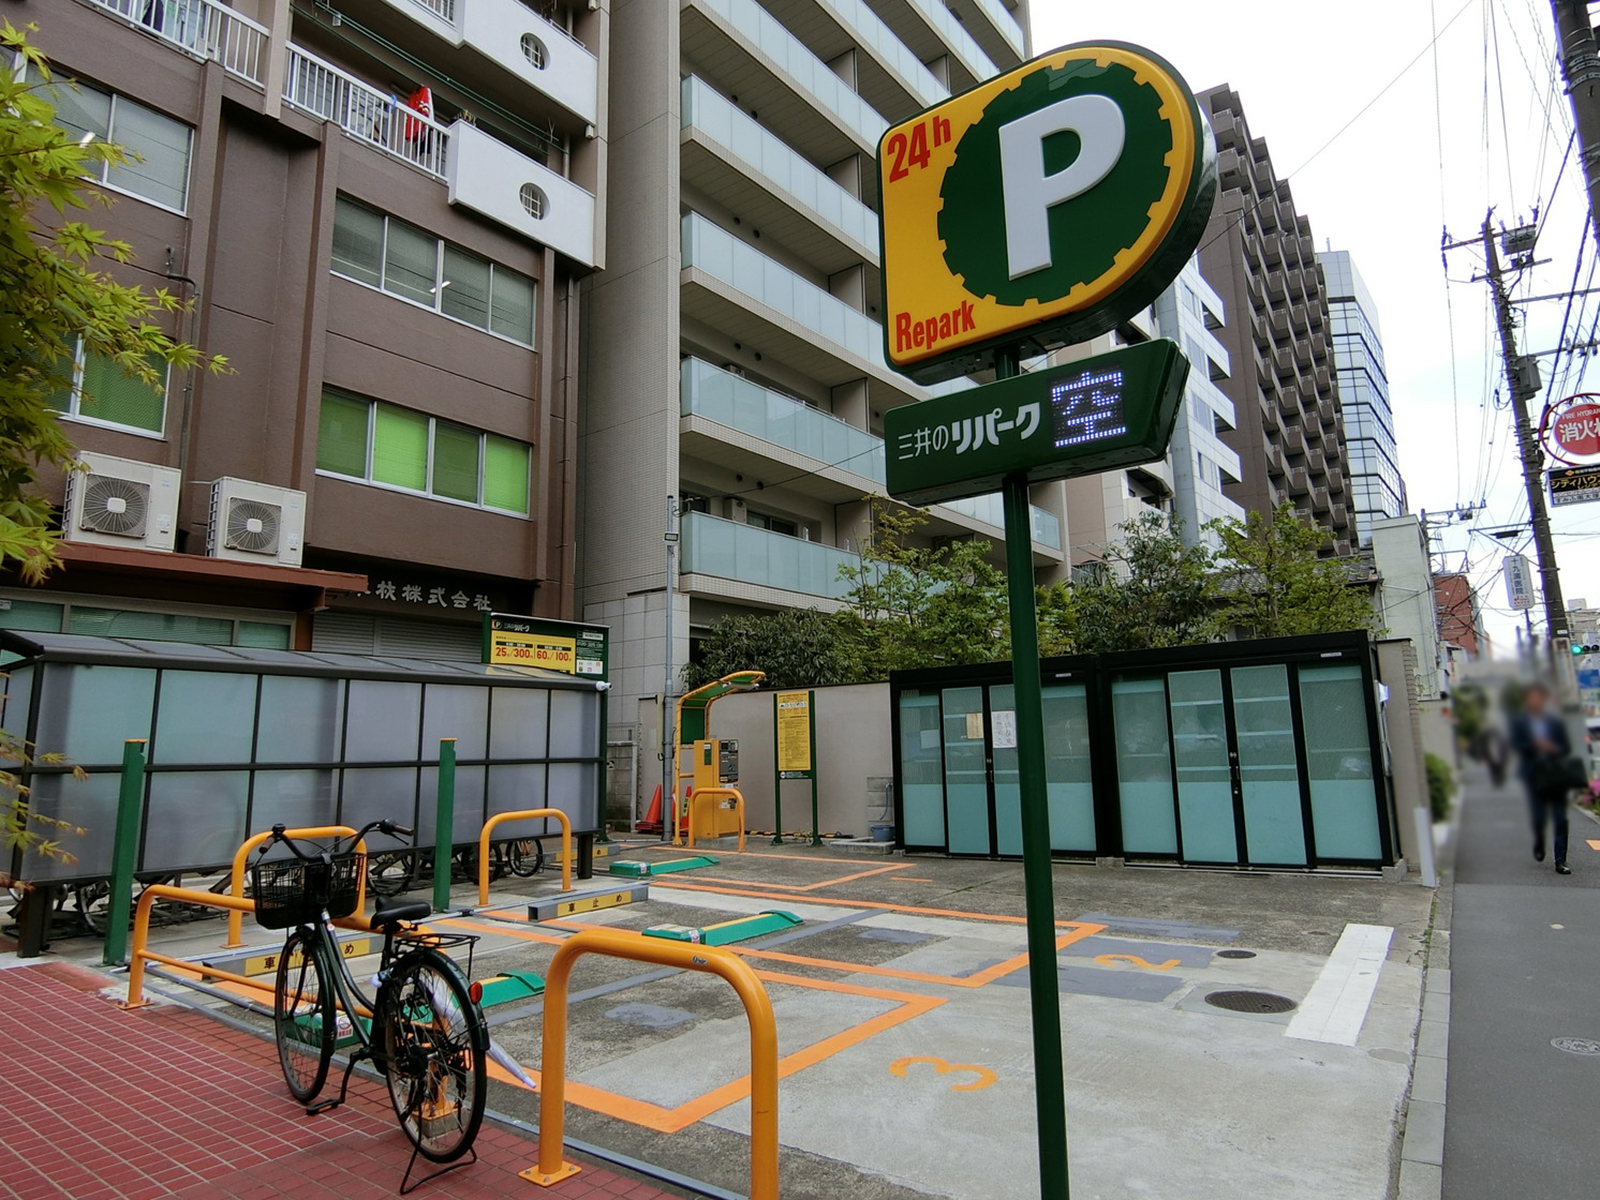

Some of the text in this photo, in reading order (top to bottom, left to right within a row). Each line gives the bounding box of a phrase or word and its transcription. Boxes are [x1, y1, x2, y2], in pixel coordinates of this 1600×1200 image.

[887, 115, 952, 183] 24h
[999, 94, 1126, 281] P
[895, 300, 976, 353] Repark
[897, 401, 1040, 461] 三井のリパーク
[1051, 371, 1127, 448] 空
[1562, 412, 1575, 420] FIRE
[1551, 475, 1600, 490] シティハウ
[1094, 953, 1182, 970] 2
[888, 1055, 998, 1093] 3
